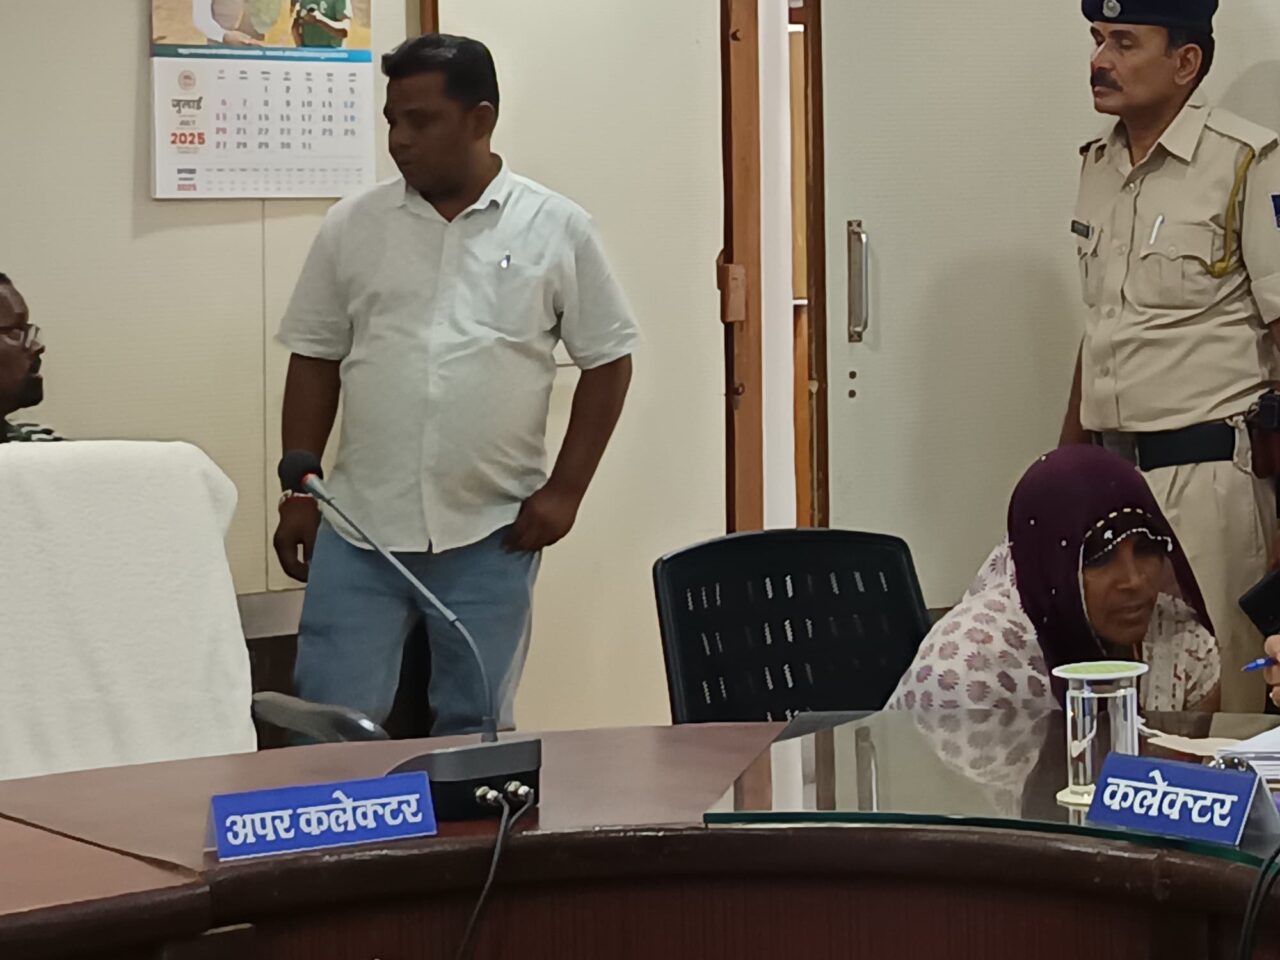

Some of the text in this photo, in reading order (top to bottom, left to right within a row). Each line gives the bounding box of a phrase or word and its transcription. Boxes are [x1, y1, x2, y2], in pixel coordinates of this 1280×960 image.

[171, 96, 203, 114] जुलाई
[170, 132, 206, 145] 2025
[1103, 769, 1238, 827] कलेक्टर
[226, 790, 423, 845] अपर कलेक्टर
